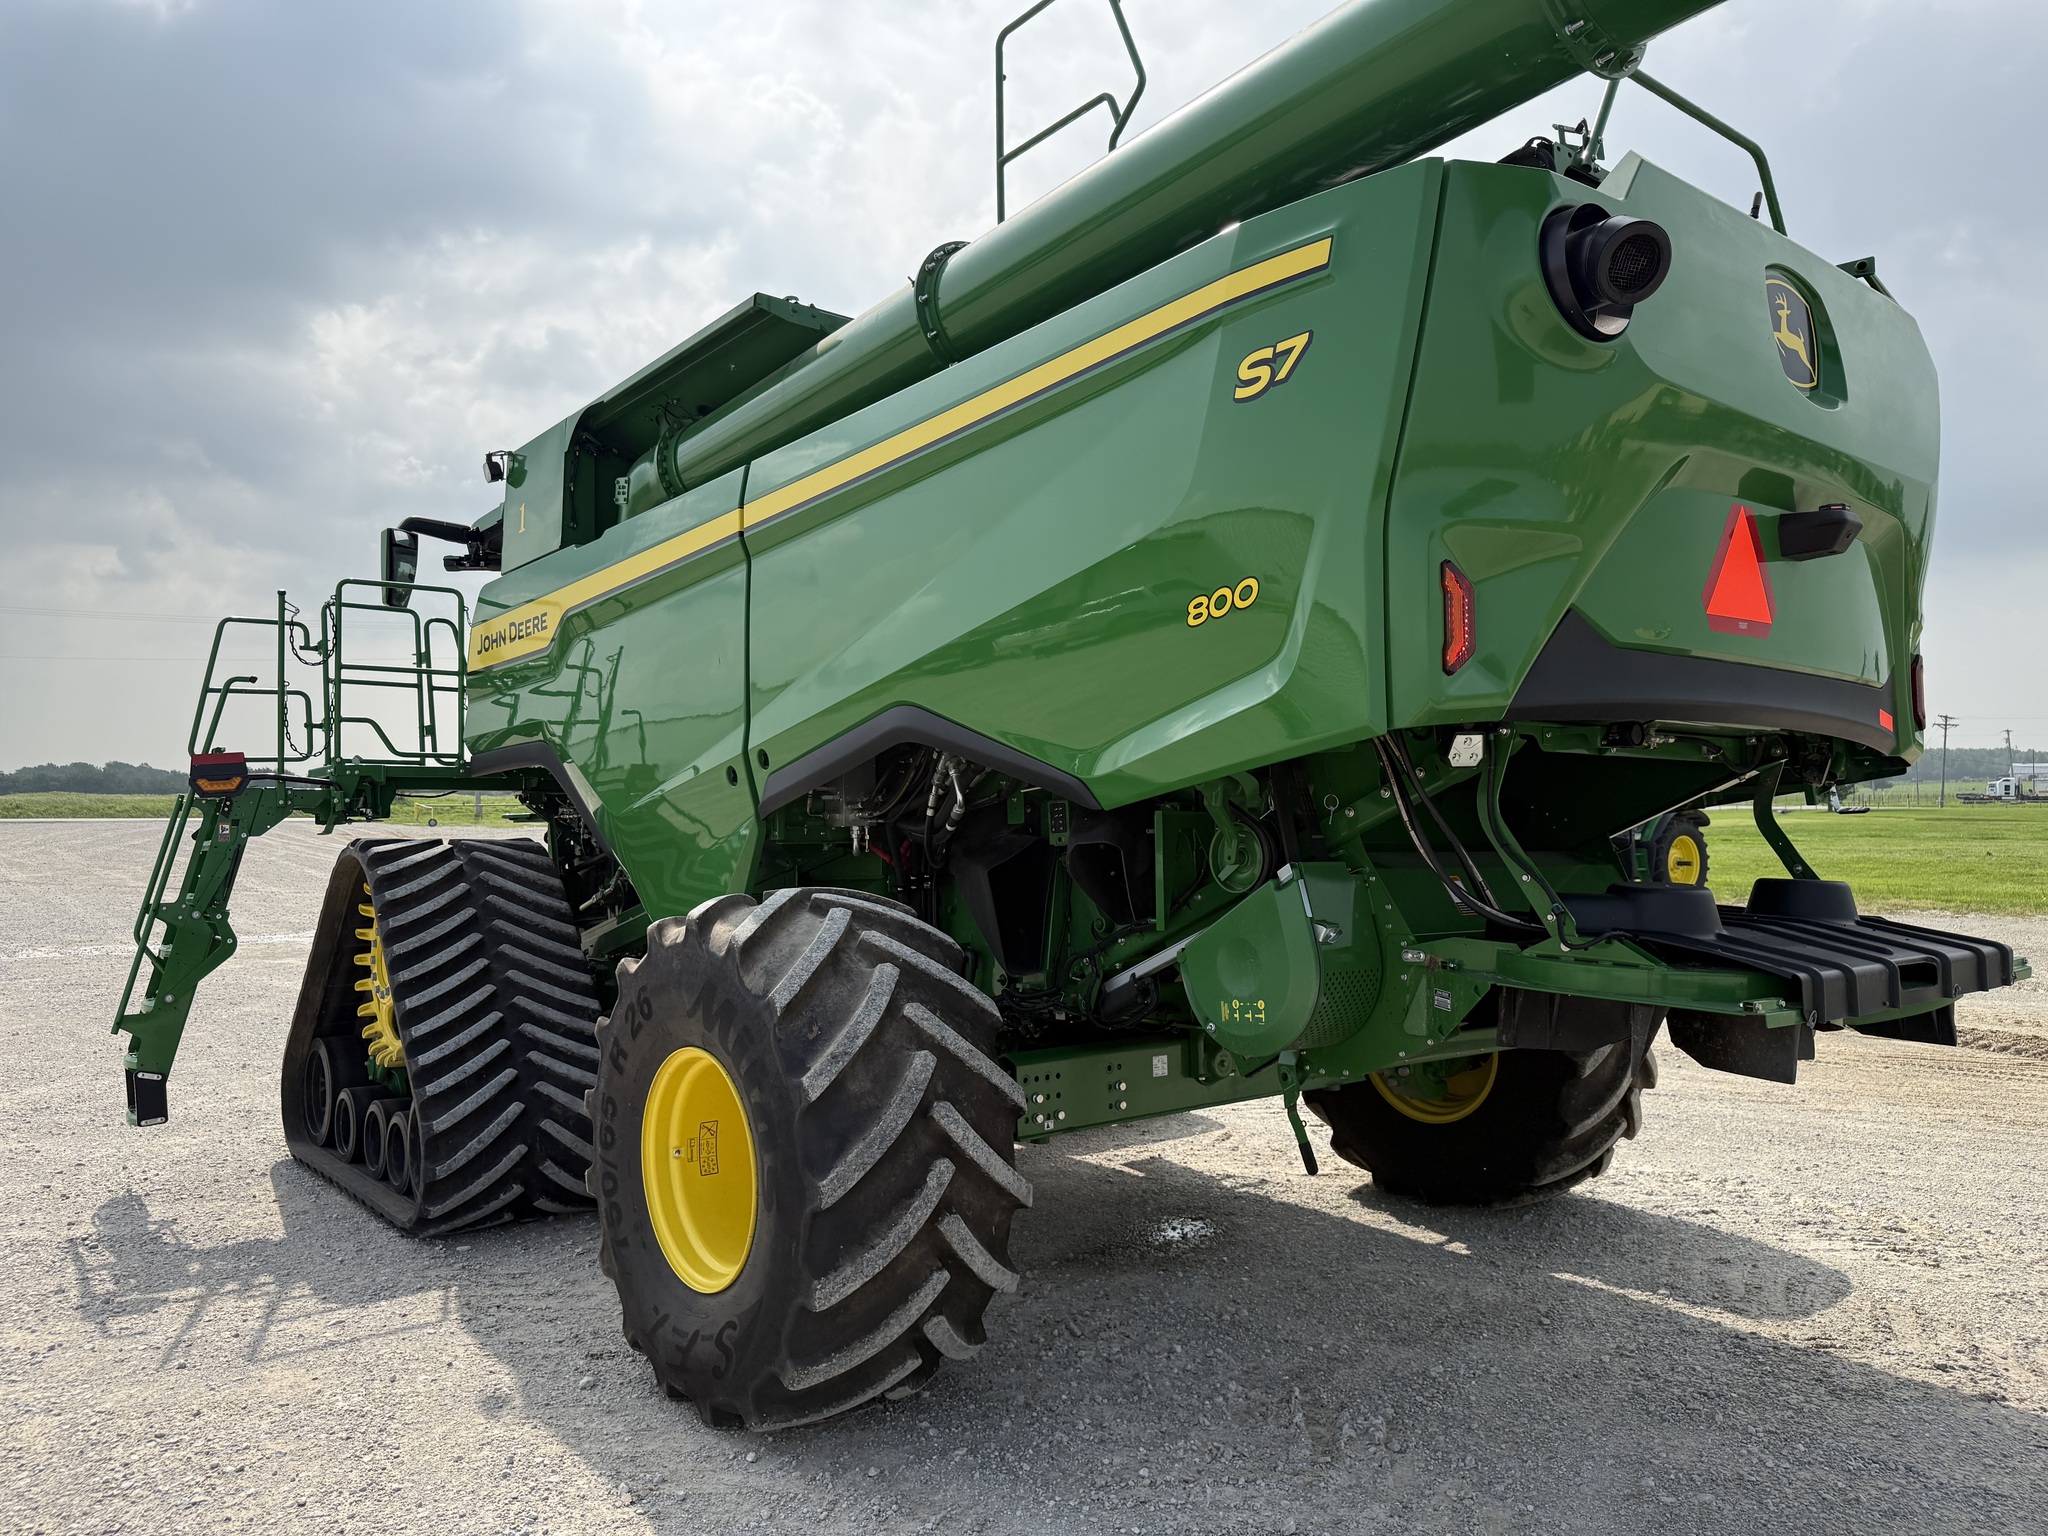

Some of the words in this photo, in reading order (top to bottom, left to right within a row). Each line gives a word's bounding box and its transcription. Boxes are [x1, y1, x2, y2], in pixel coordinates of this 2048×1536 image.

[1233, 329, 1314, 404] S7
[518, 502, 526, 534] 1
[1186, 576, 1260, 627] 800
[477, 630, 507, 656] JOHN
[508, 612, 548, 643] DEERE
[624, 984, 654, 1041] 26
[608, 1036, 630, 1077] R
[598, 1091, 631, 1251] 750/65
